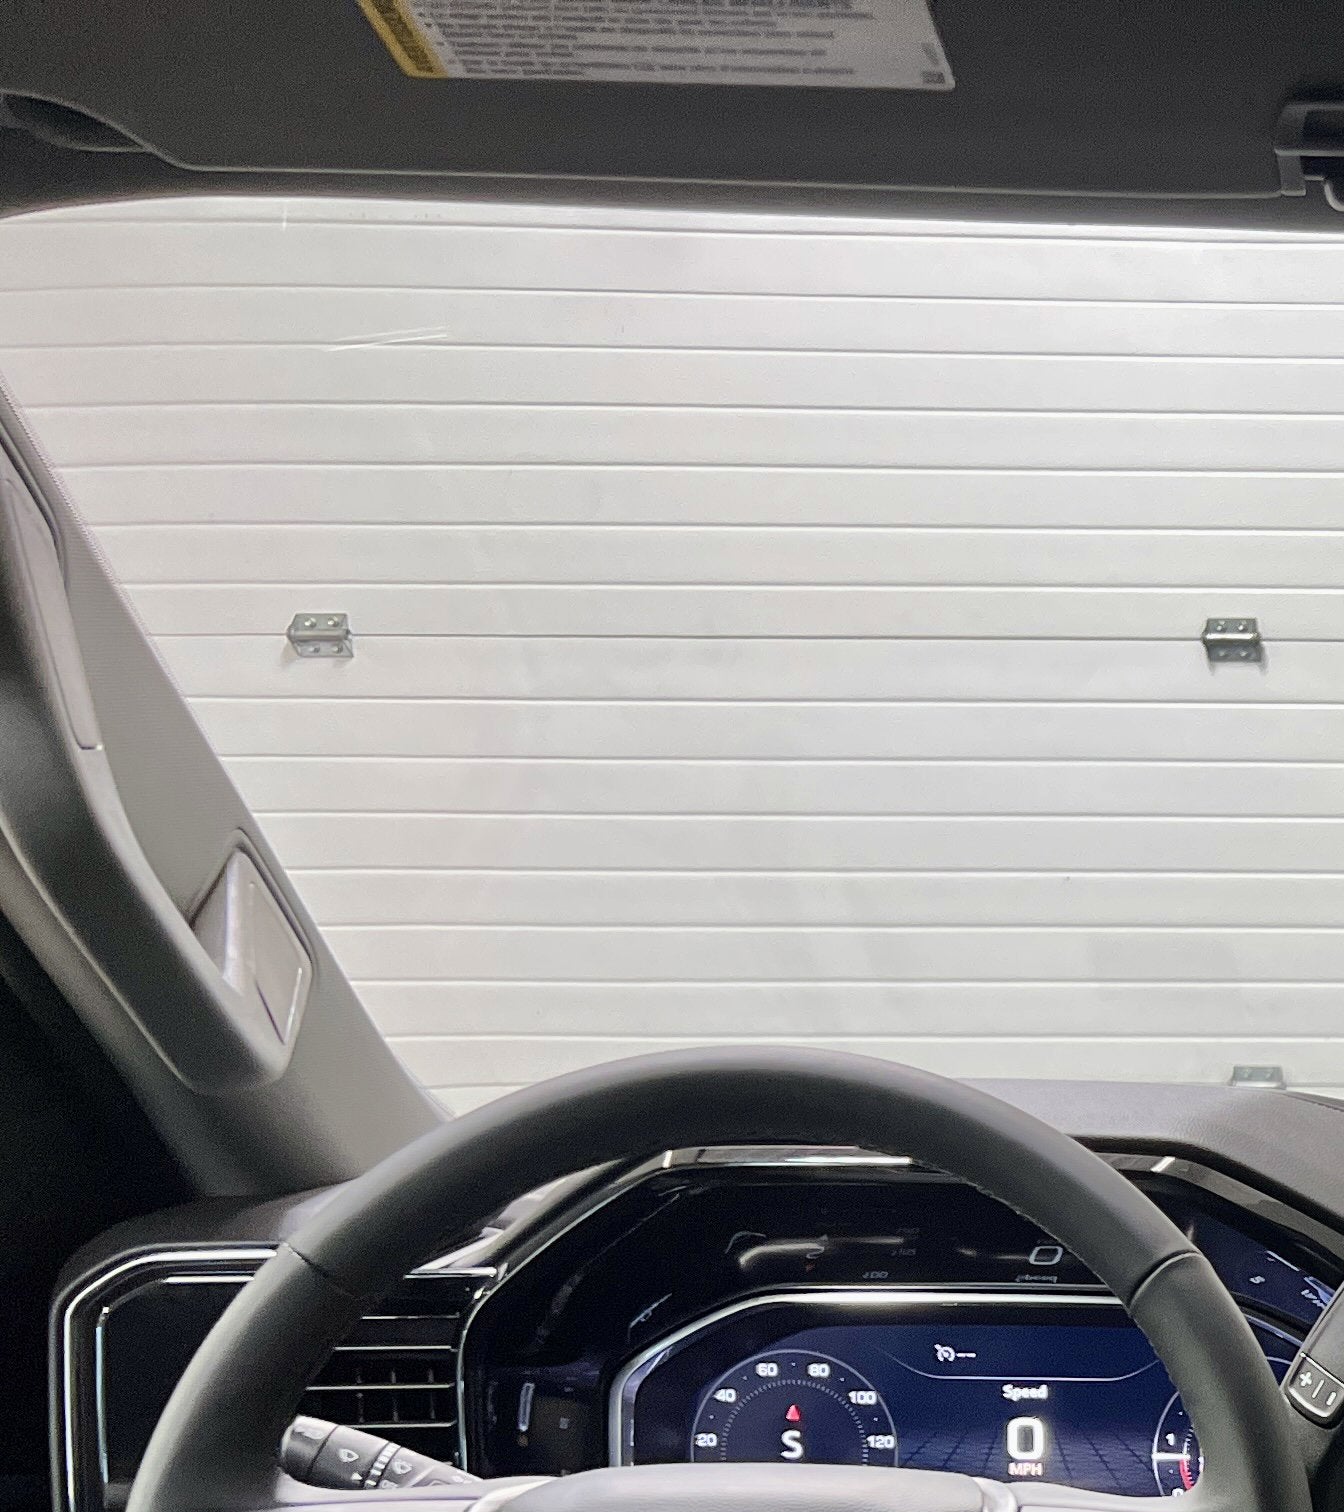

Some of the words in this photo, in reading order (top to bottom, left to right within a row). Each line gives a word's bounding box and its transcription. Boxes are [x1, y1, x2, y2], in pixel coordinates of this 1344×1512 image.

[756, 1363, 778, 1377] 60
[808, 1363, 830, 1378] 80
[714, 1389, 737, 1403] 40
[849, 1390, 877, 1405] 100
[1002, 1384, 1048, 1401] Speed
[694, 1433, 718, 1447] 20
[780, 1429, 804, 1459] S
[866, 1435, 895, 1449] 120
[1006, 1416, 1044, 1460] 0
[1008, 1462, 1043, 1476] MPH
